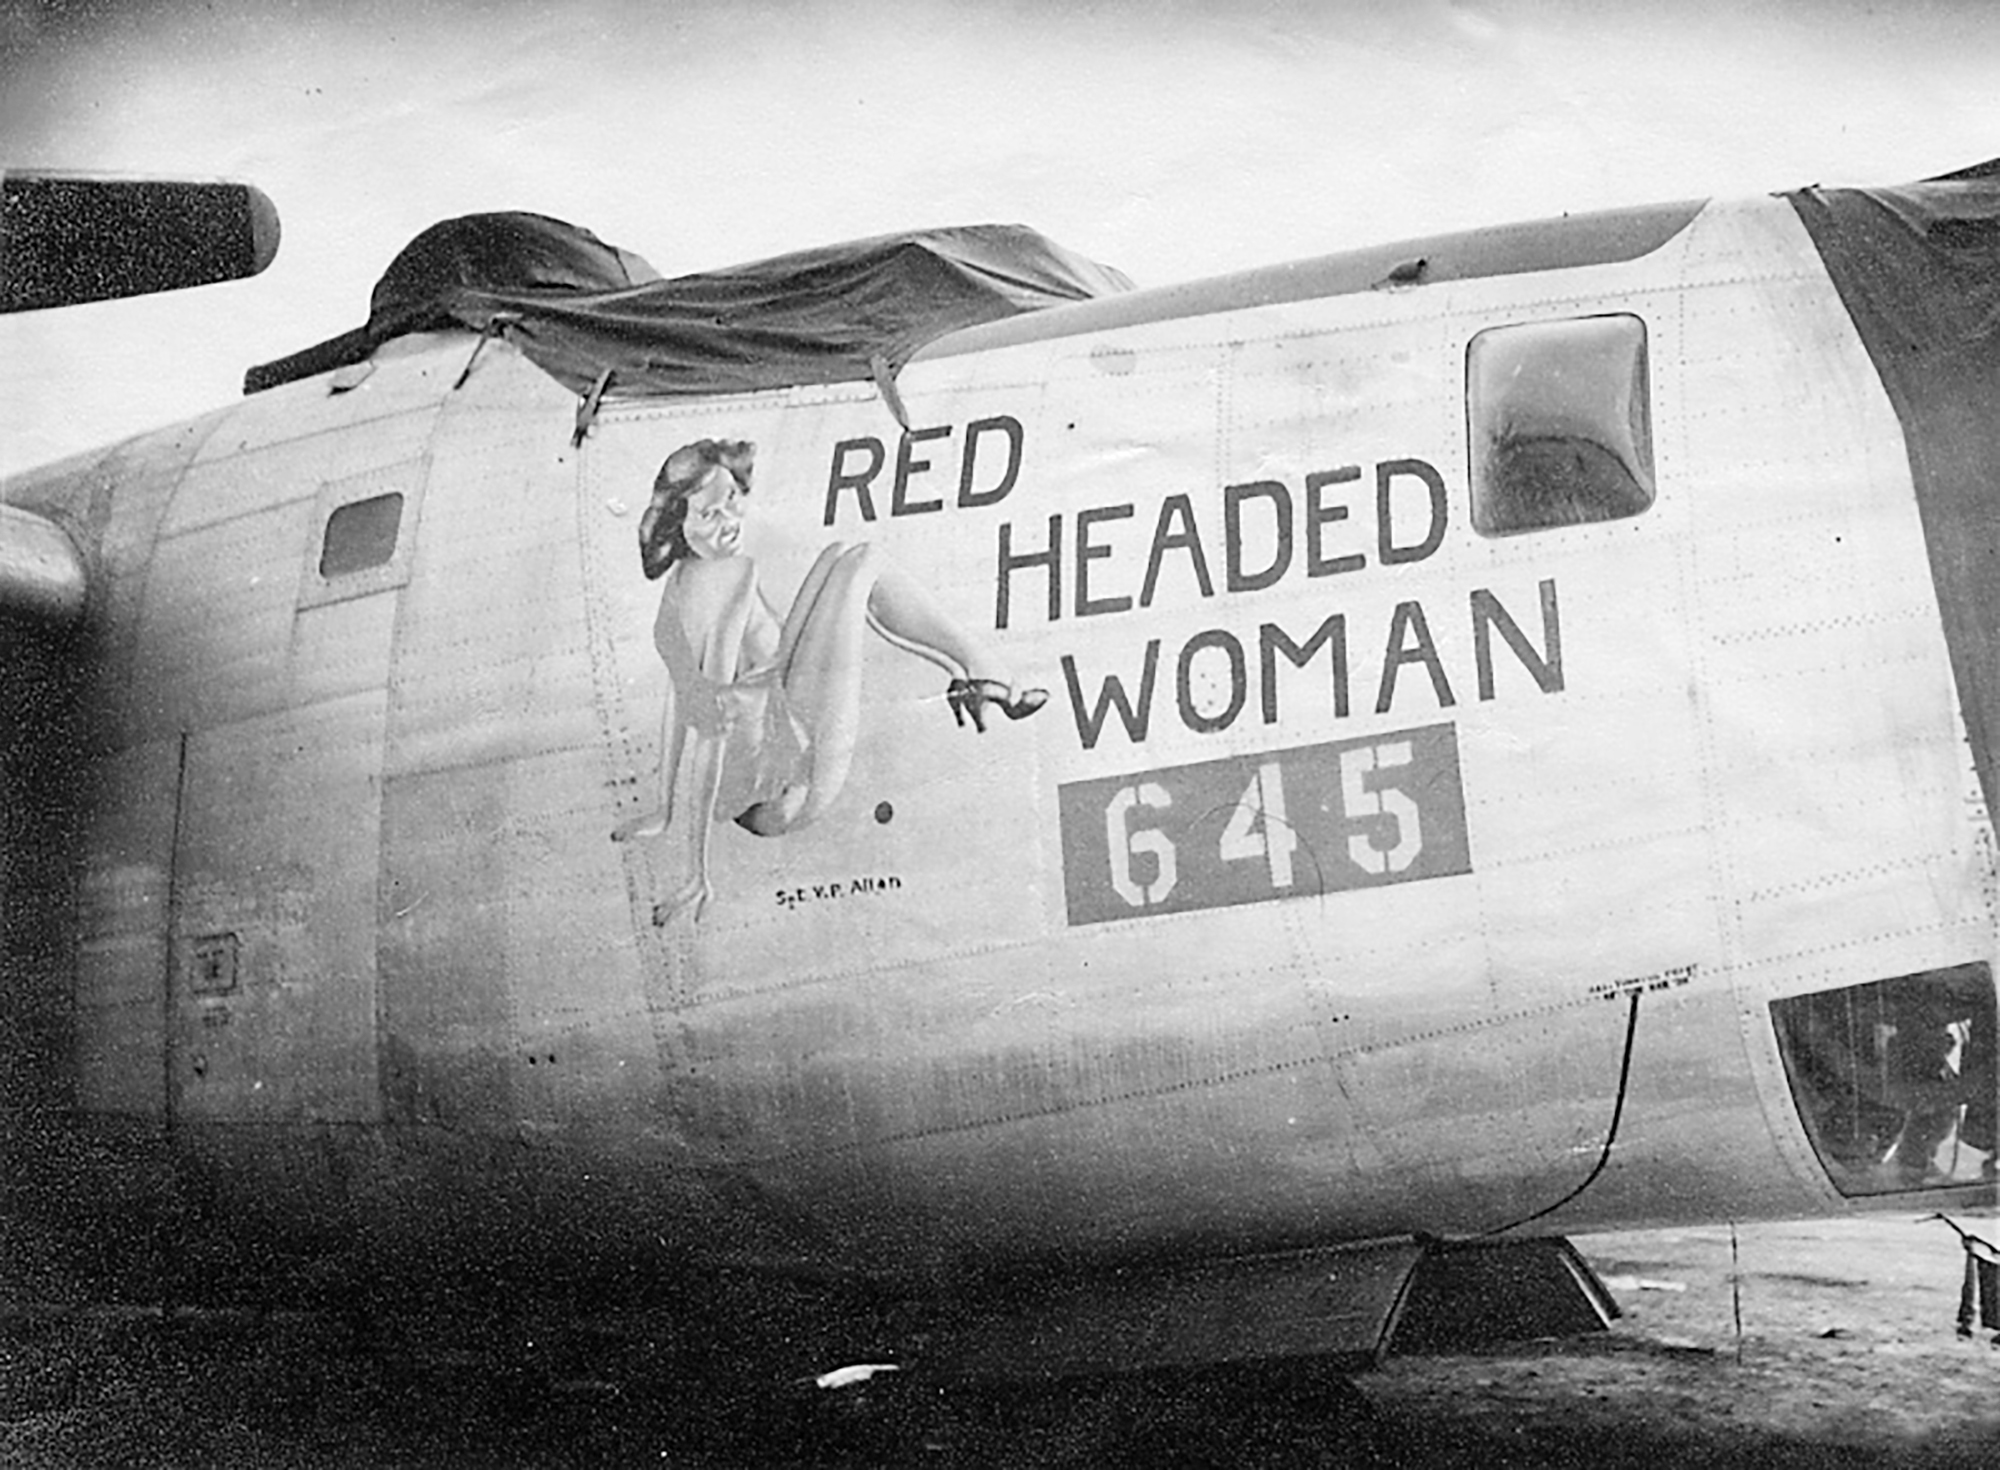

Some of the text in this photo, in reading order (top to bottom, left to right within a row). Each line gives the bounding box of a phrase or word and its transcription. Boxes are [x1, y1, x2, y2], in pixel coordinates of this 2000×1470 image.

[825, 416, 1023, 525] RED
[996, 459, 1447, 629] HEADED
[1062, 580, 1564, 749] WOMAN
[1105, 743, 1423, 907] 645
